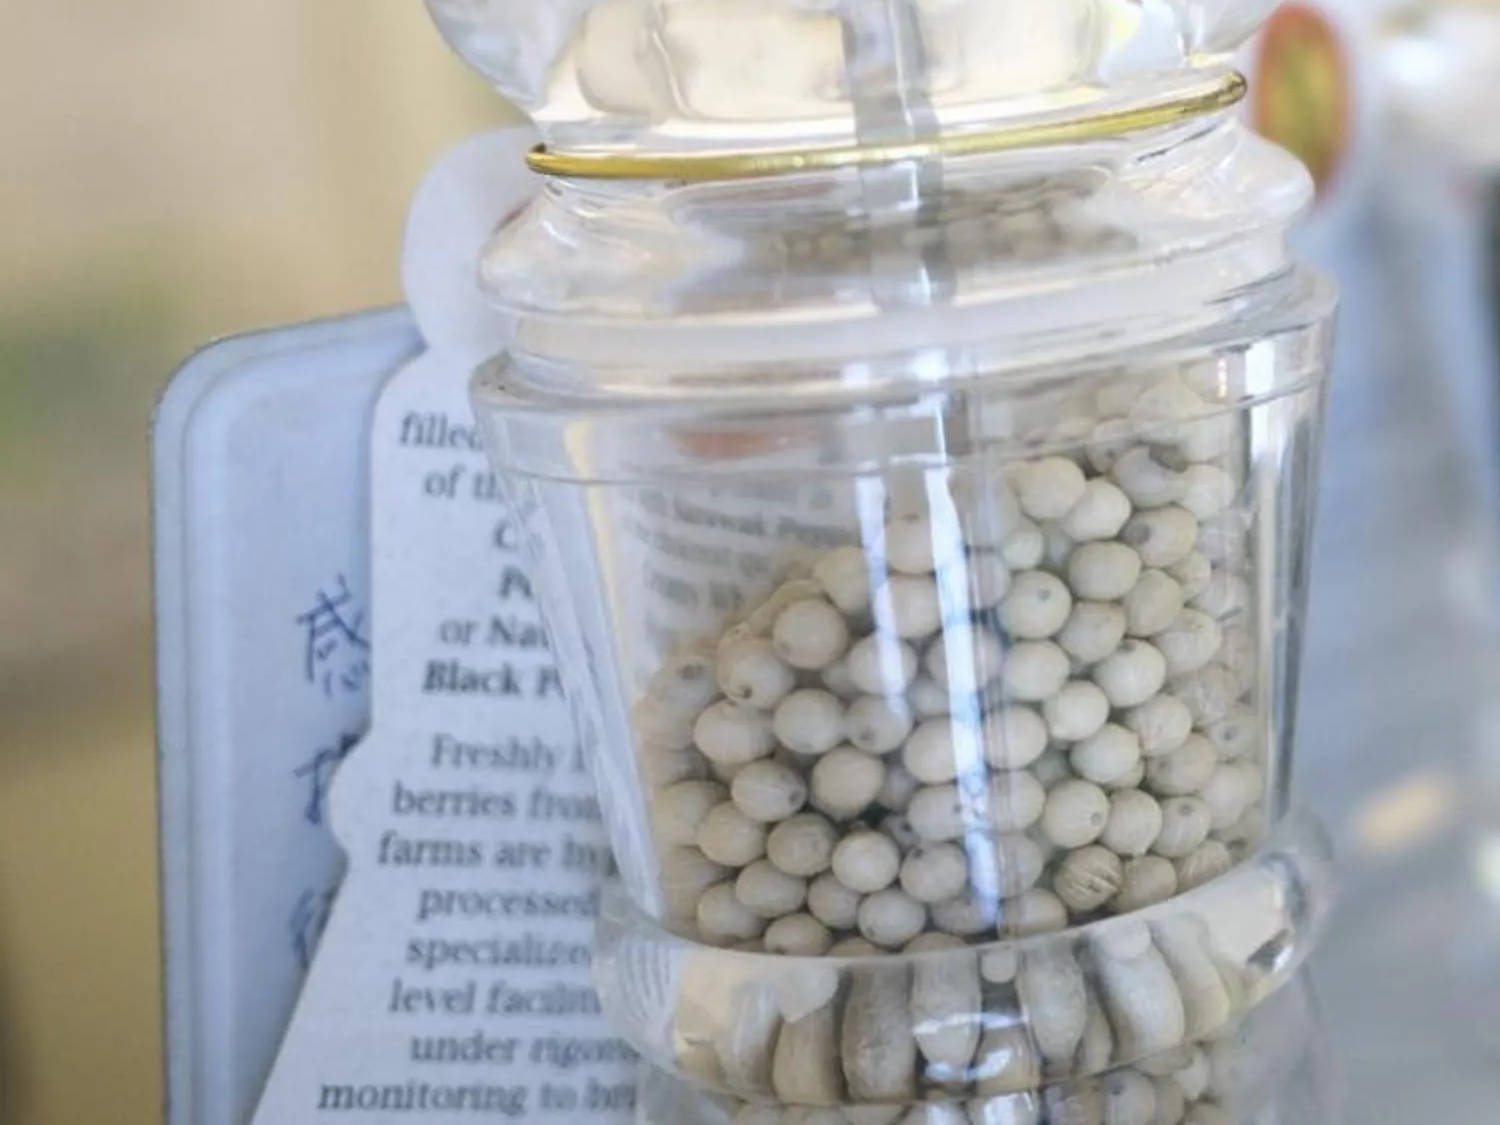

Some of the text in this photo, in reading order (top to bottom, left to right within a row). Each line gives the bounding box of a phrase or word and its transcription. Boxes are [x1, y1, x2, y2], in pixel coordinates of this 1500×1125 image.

[423, 464, 466, 500] of
[438, 619, 478, 646] or
[422, 658, 522, 695] Black
[392, 780, 517, 817] berries
[377, 829, 482, 867] farms
[494, 841, 552, 868] are
[388, 978, 476, 1014] level
[410, 1030, 519, 1062] under
[316, 1082, 529, 1117] monitoring
